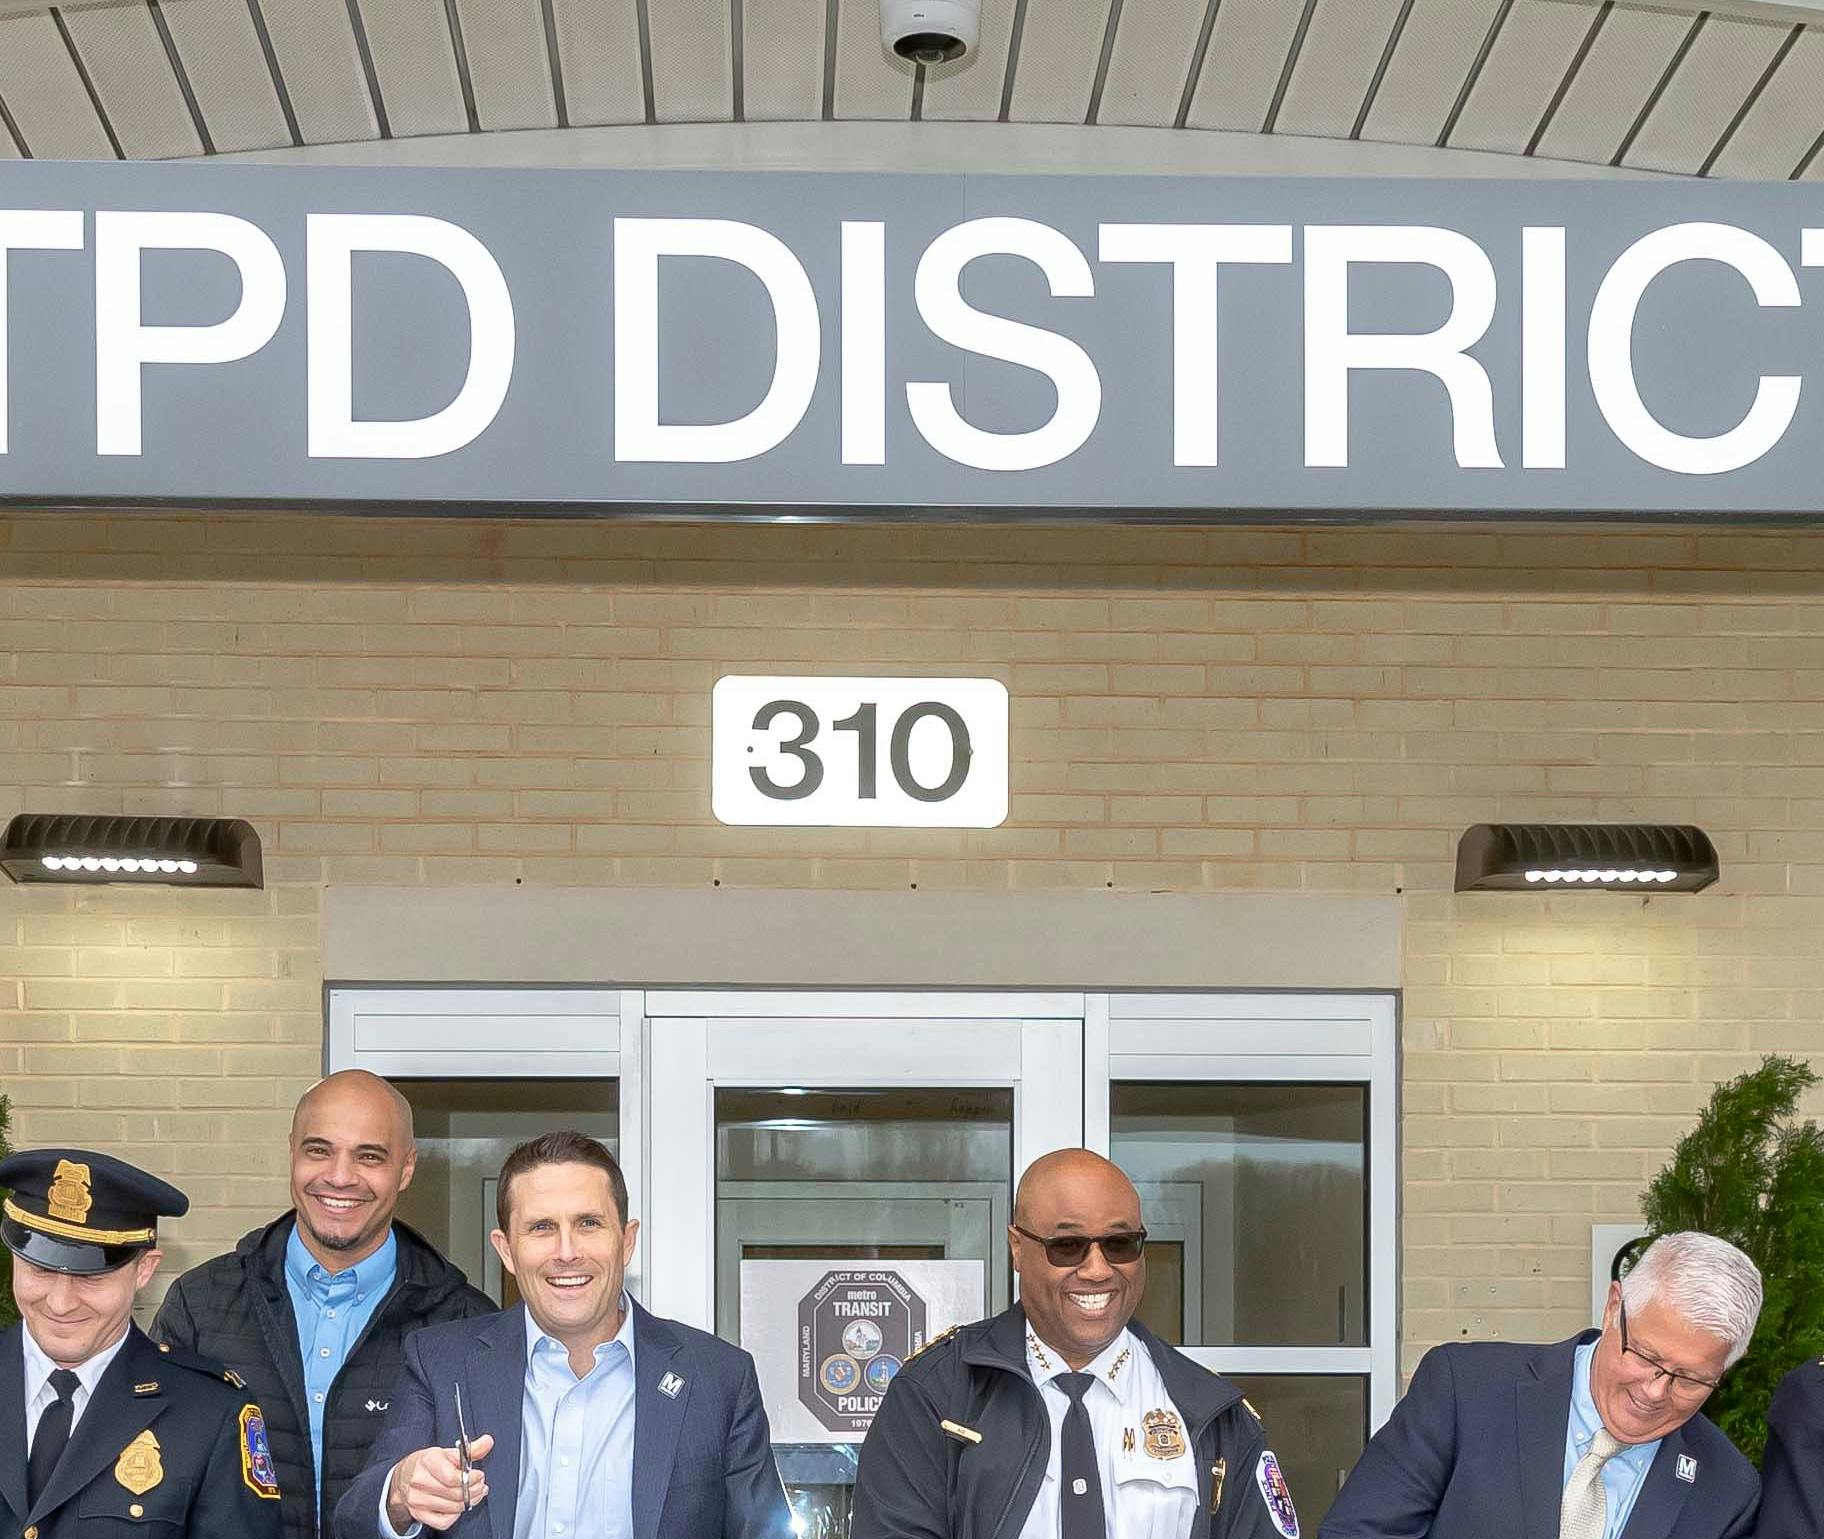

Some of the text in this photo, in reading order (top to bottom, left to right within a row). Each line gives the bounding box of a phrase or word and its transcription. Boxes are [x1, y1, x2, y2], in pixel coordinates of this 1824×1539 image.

[749, 700, 972, 802] 310
[814, 1273, 912, 1302] DISTRICT OF COLUMBIA
[848, 1290, 877, 1300] metro
[833, 1302, 892, 1317] TRANSIT
[802, 1325, 810, 1378] MARYLAND
